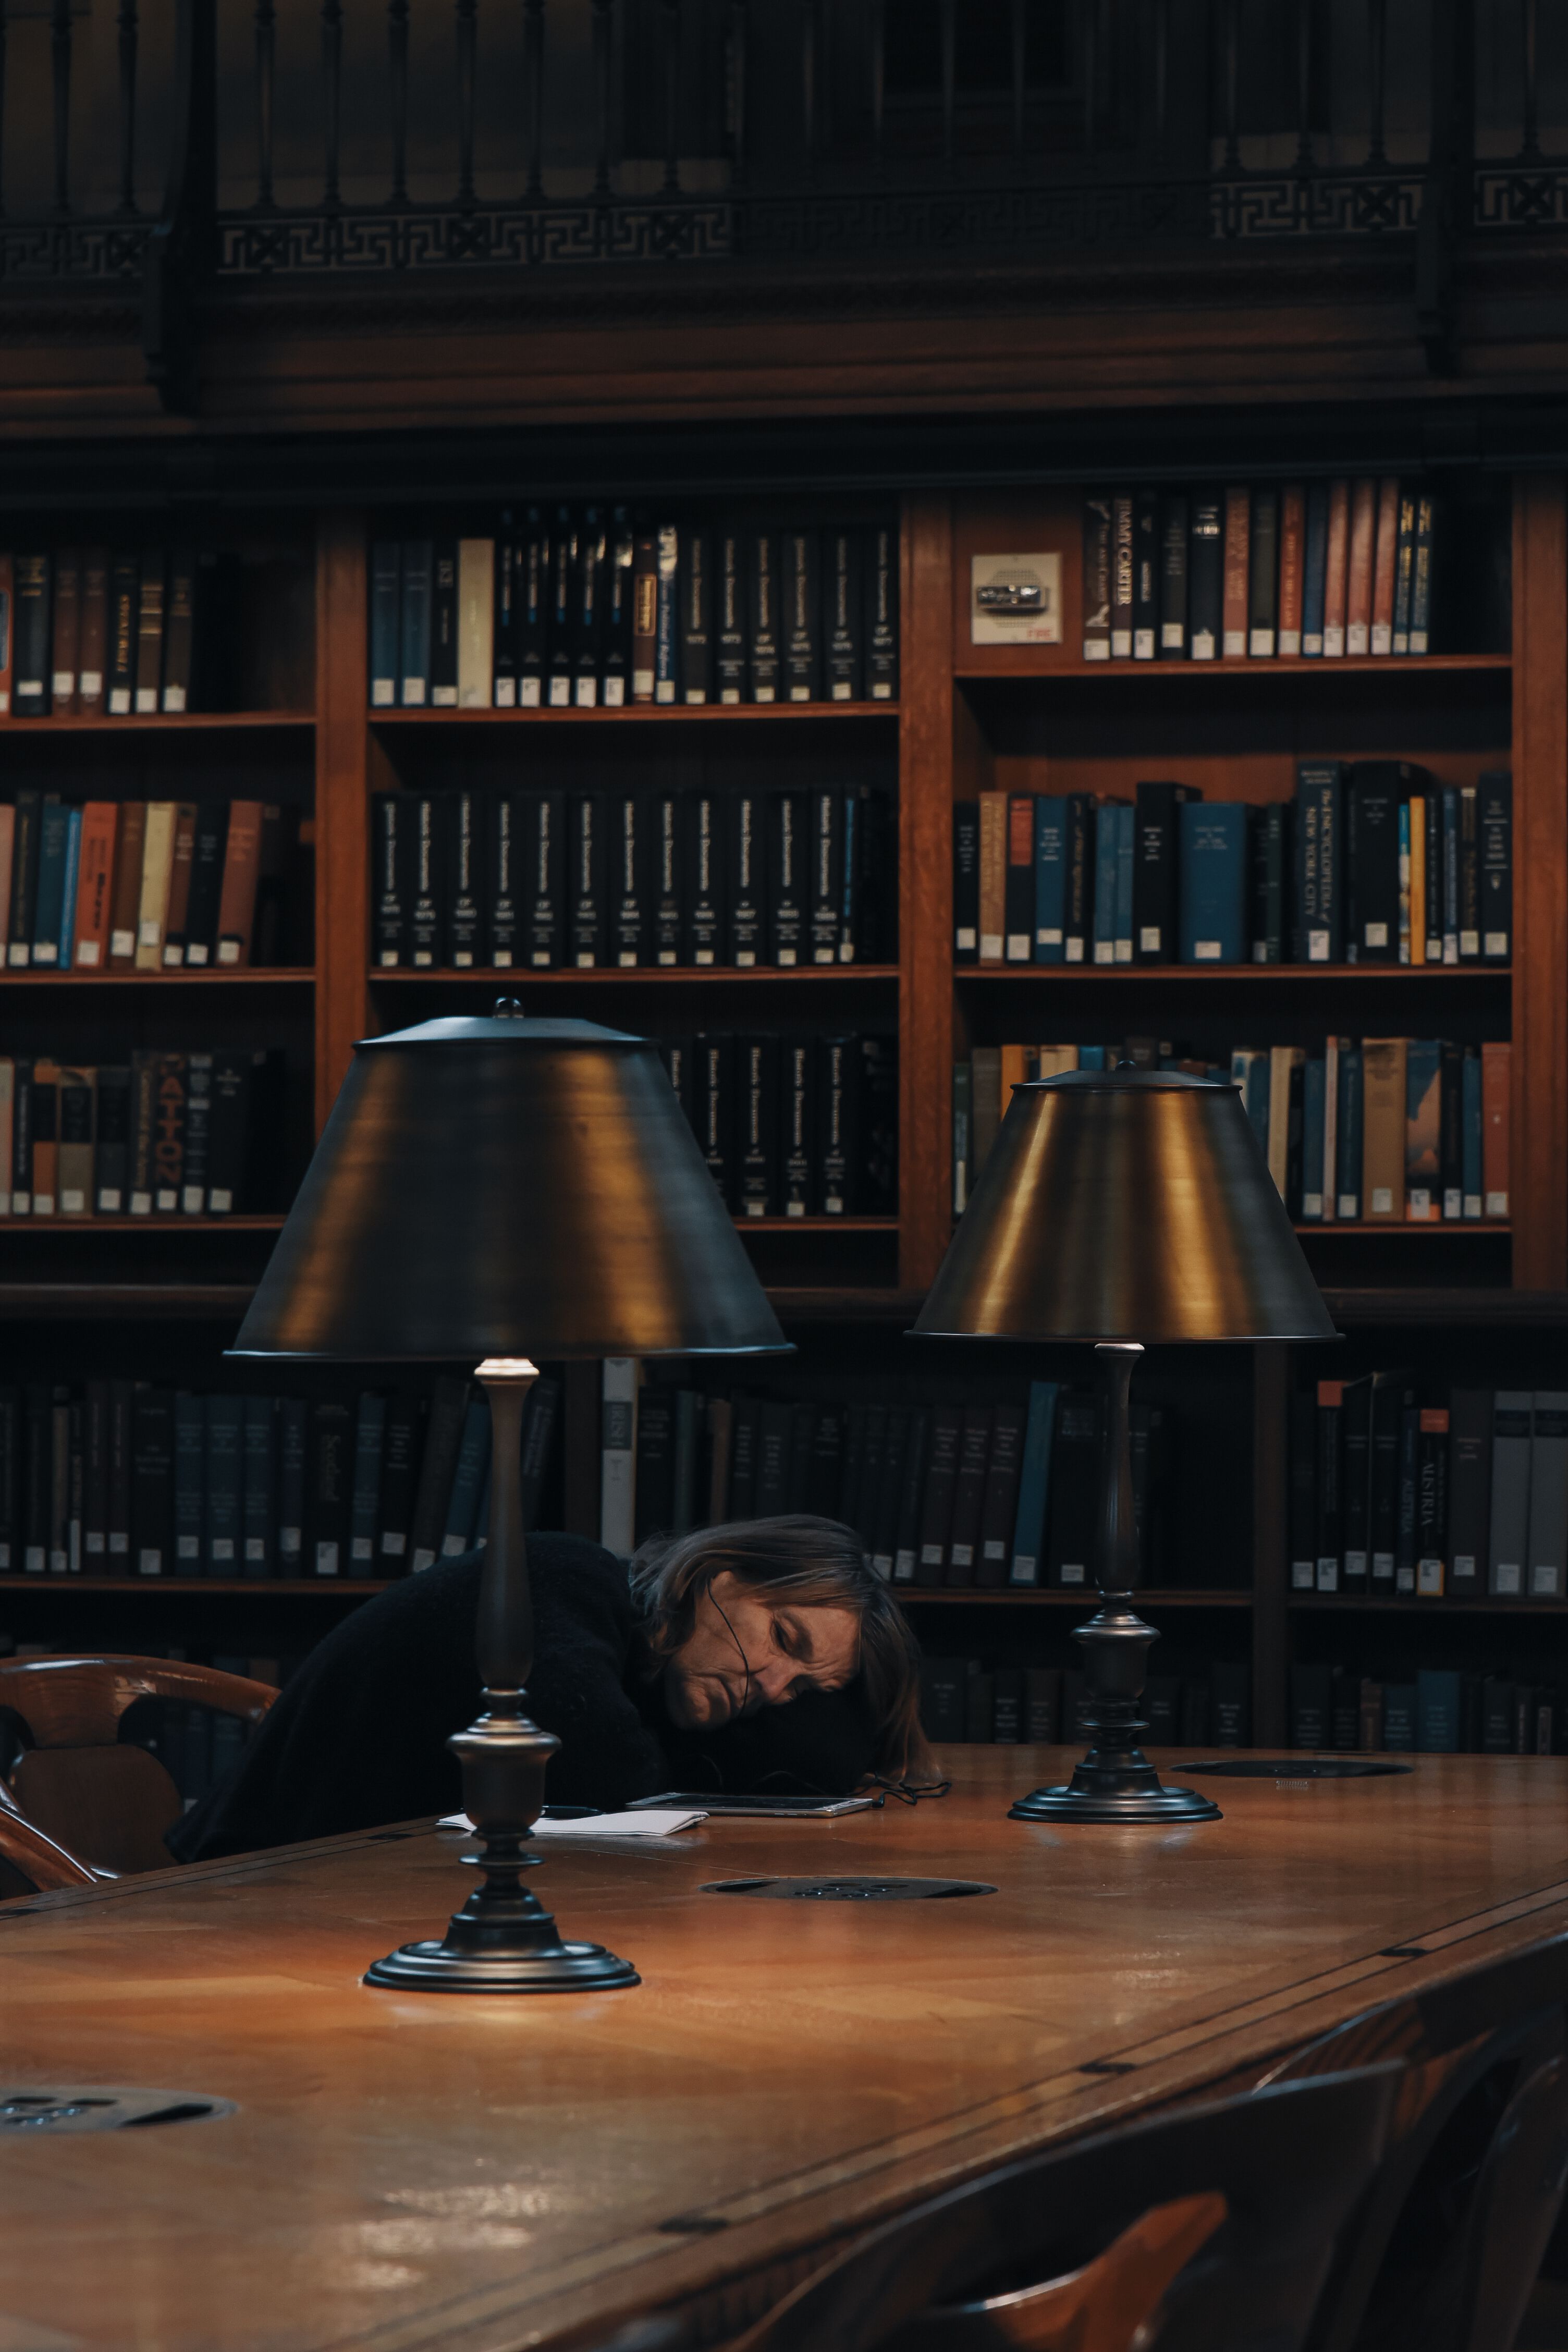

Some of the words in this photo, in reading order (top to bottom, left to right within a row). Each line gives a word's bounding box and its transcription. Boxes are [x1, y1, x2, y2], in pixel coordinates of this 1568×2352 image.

[1118, 498, 1132, 545] JIMMY
[1118, 546, 1132, 604] CARTER
[1305, 805, 1317, 838] NEW
[1305, 841, 1317, 880] YORK
[1320, 805, 1333, 908] ENCYCLOPEDIA
[1305, 882, 1317, 916] CITY
[1422, 1459, 1435, 1525] AUSTRIA
